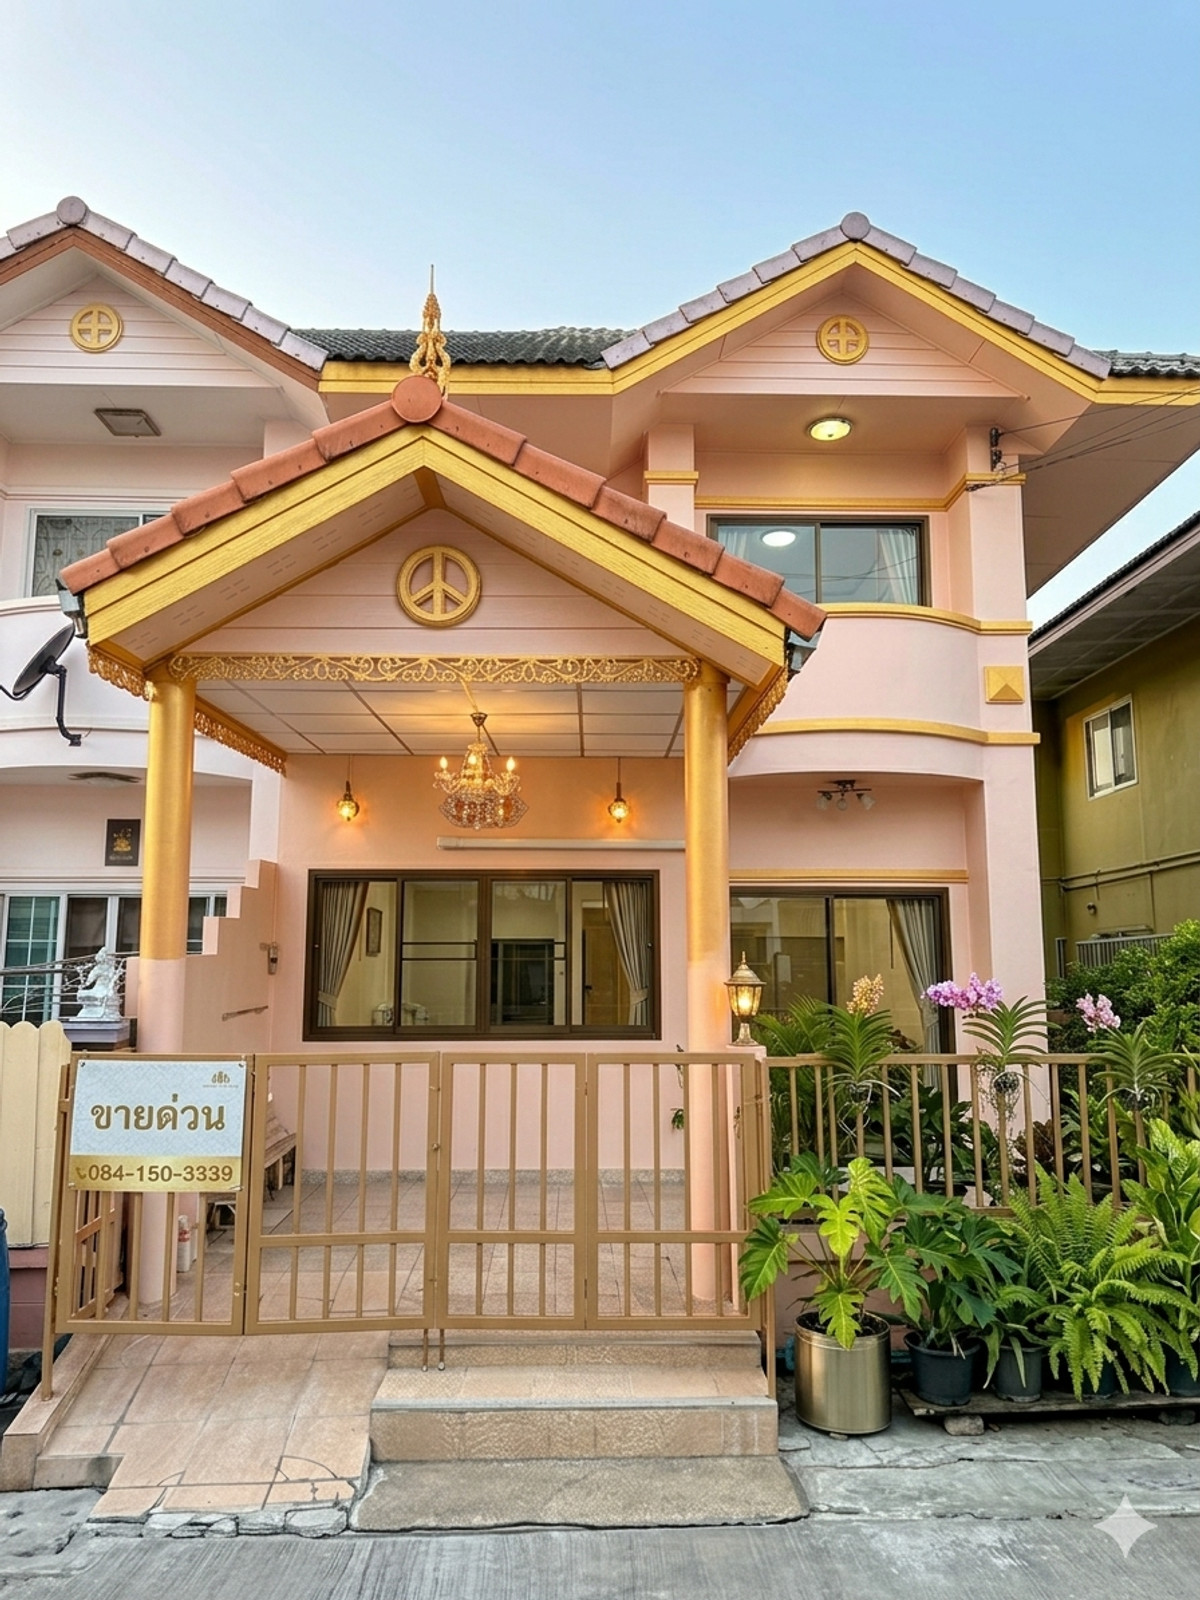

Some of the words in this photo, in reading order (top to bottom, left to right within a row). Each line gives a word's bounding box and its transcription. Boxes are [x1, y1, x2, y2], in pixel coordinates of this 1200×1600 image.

[91, 1093, 225, 1131] ขายด่วน
[88, 1164, 233, 1182] 084-150-3339
